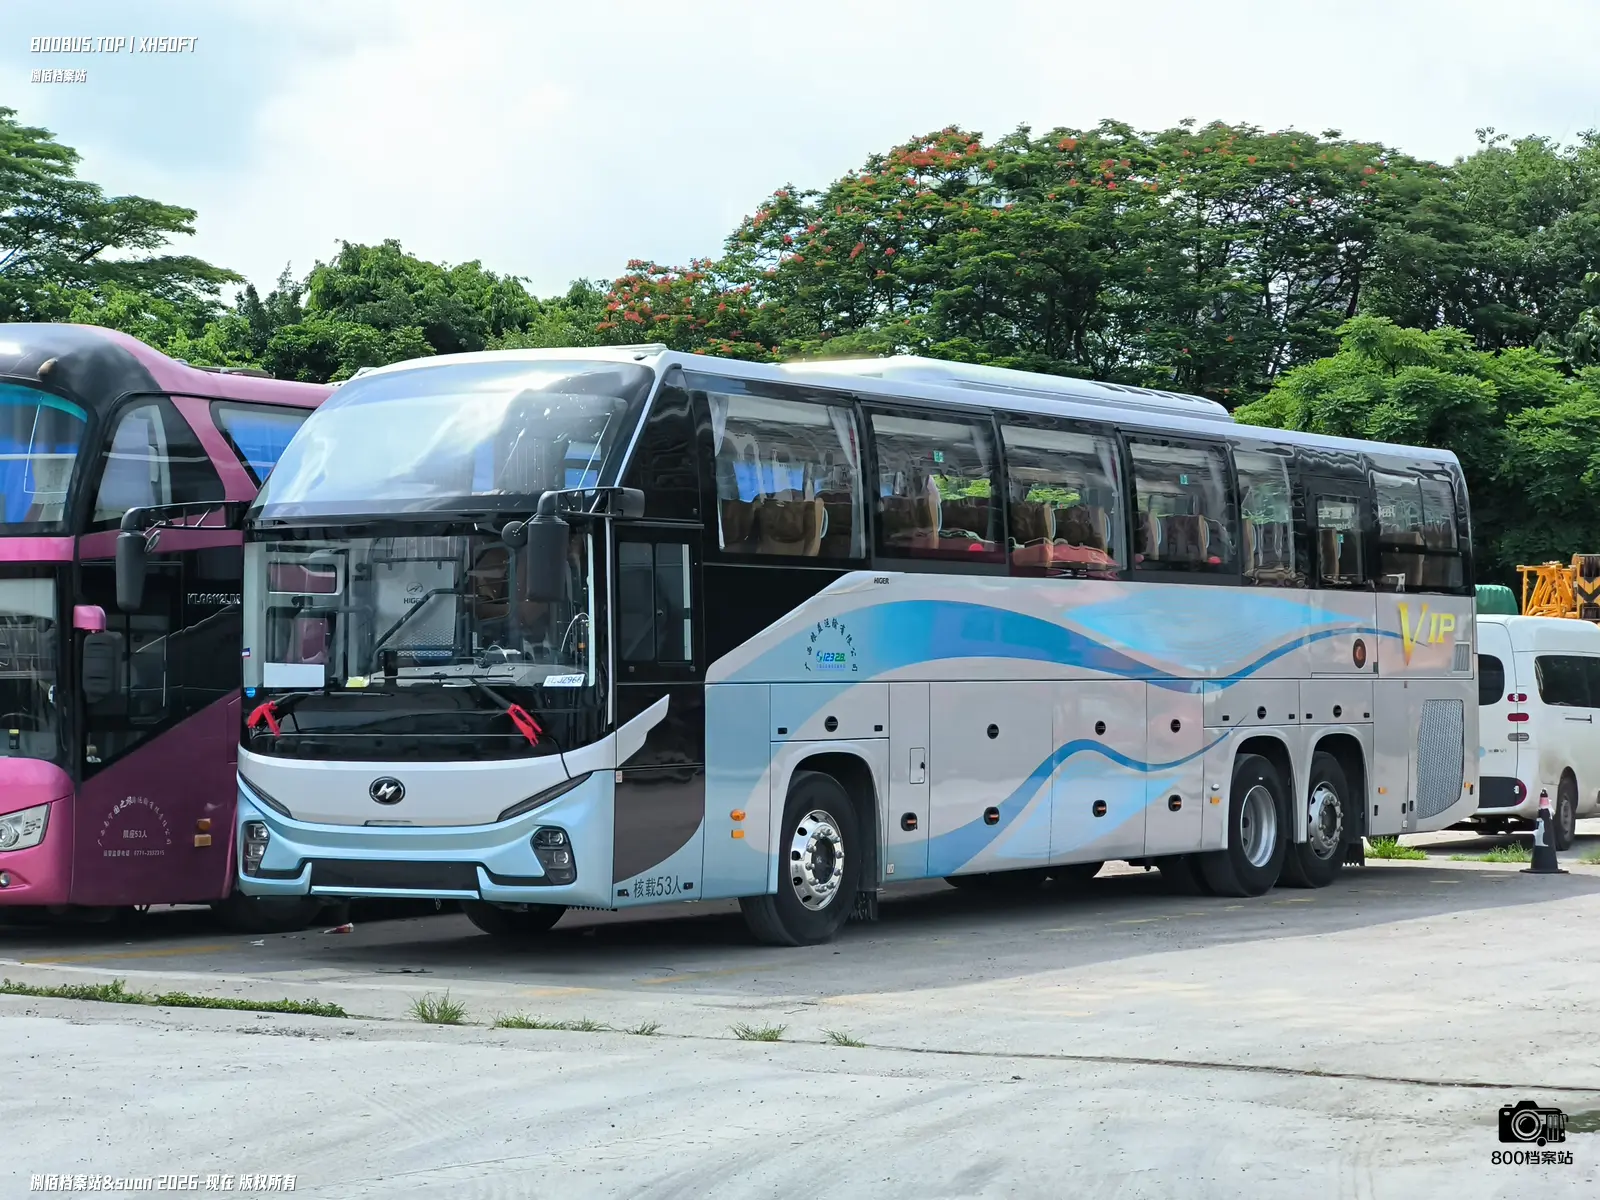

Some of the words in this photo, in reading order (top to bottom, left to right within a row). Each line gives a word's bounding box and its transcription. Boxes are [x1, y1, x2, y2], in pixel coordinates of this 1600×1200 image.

[873, 577, 890, 585] HIGER
[1398, 602, 1456, 668] VIP
[822, 652, 847, 662] 12328
[633, 874, 682, 899] 核载53人
